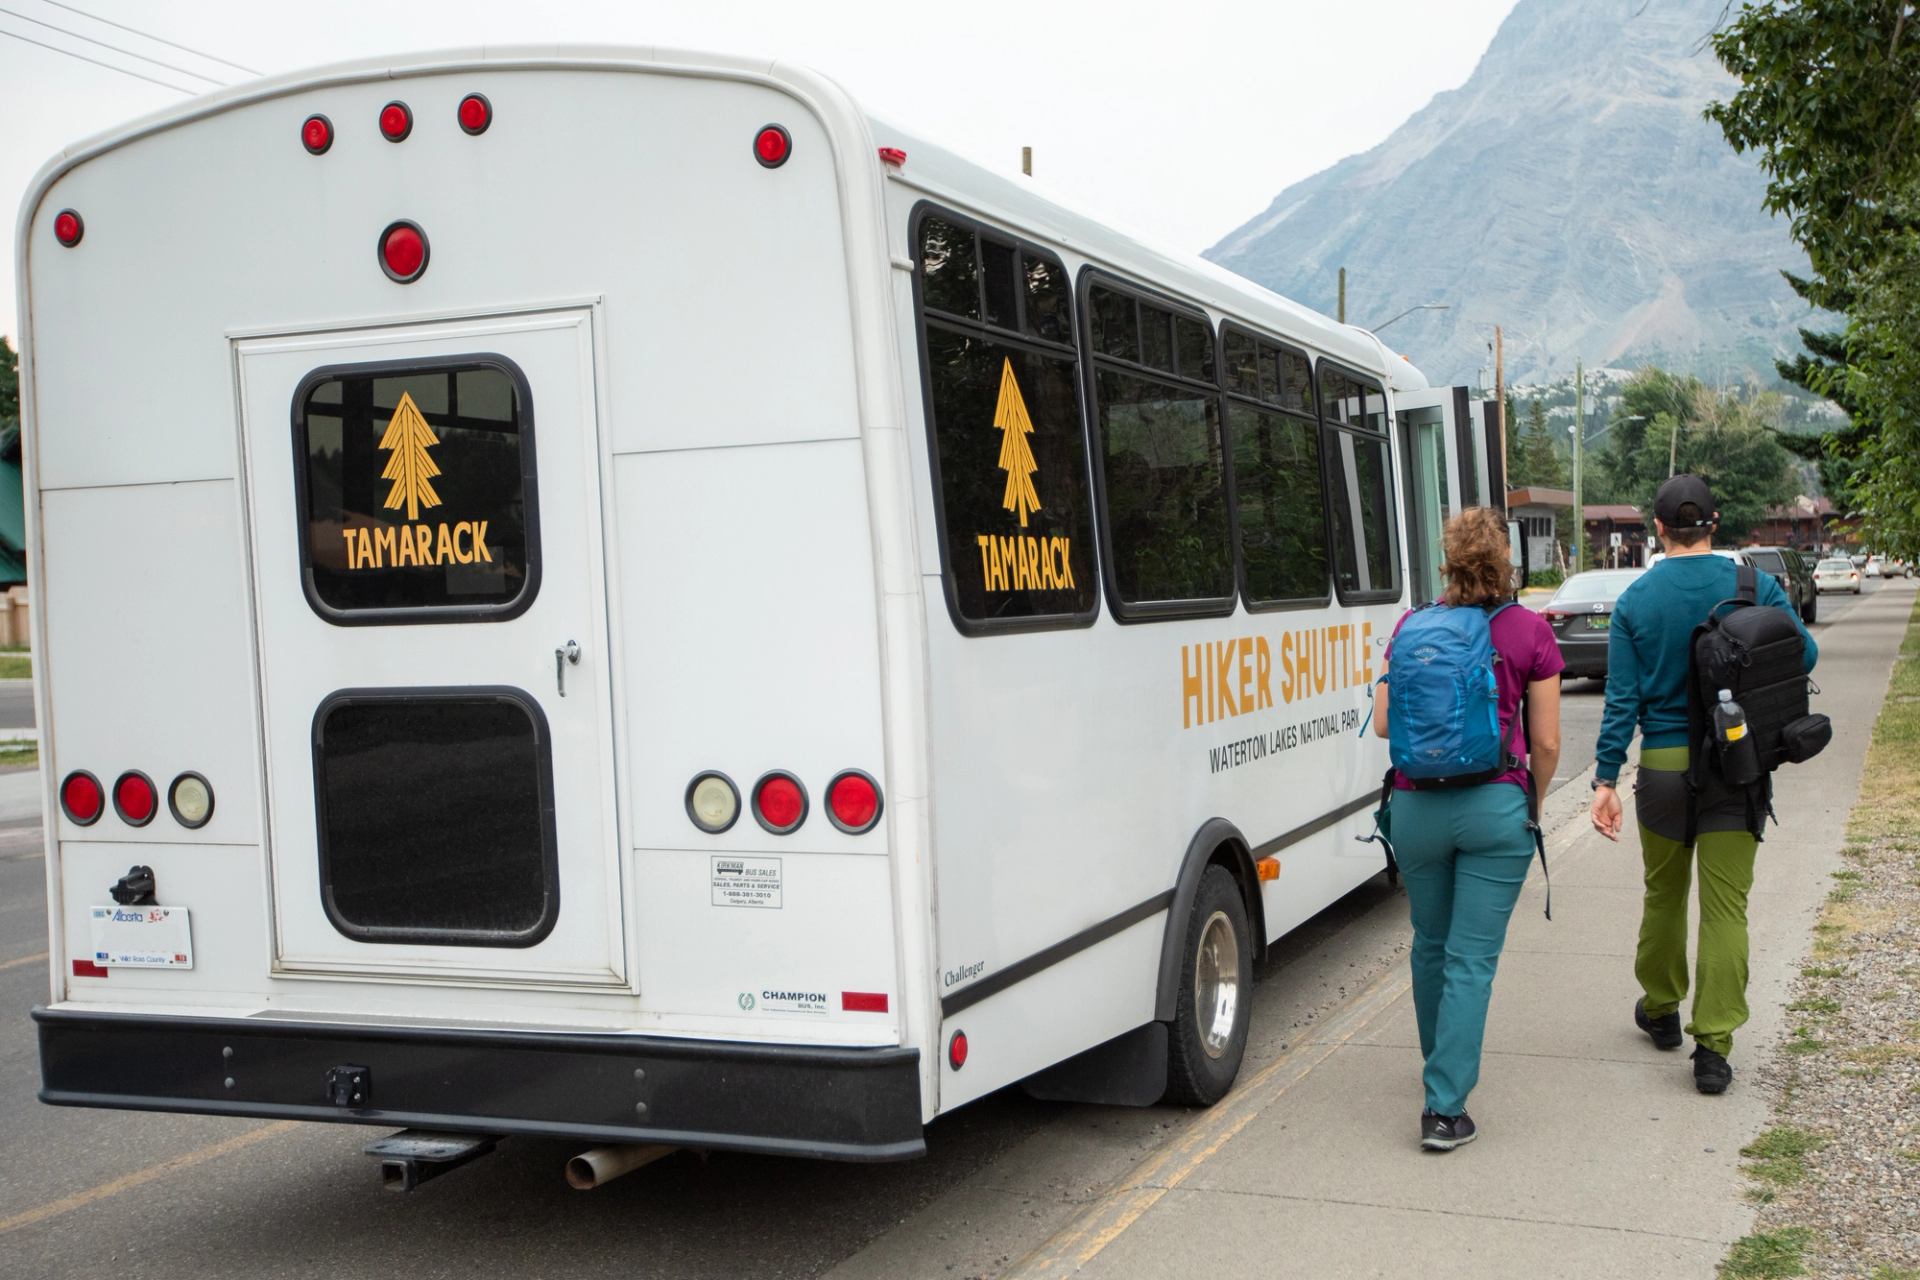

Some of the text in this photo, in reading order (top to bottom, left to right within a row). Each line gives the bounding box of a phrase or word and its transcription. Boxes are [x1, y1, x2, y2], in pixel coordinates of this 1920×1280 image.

[343, 520, 493, 570] TAMARACK
[977, 534, 1076, 592] TAMARACK
[1181, 622, 1373, 730] HIKER SHUTTLE
[1209, 708, 1361, 774] WATERTON LAKES NATIONAL PARK
[758, 869, 777, 877] SALES
[112, 908, 143, 922] Alberta
[944, 960, 985, 987] Challenger
[762, 991, 827, 1003] CHAMPION
